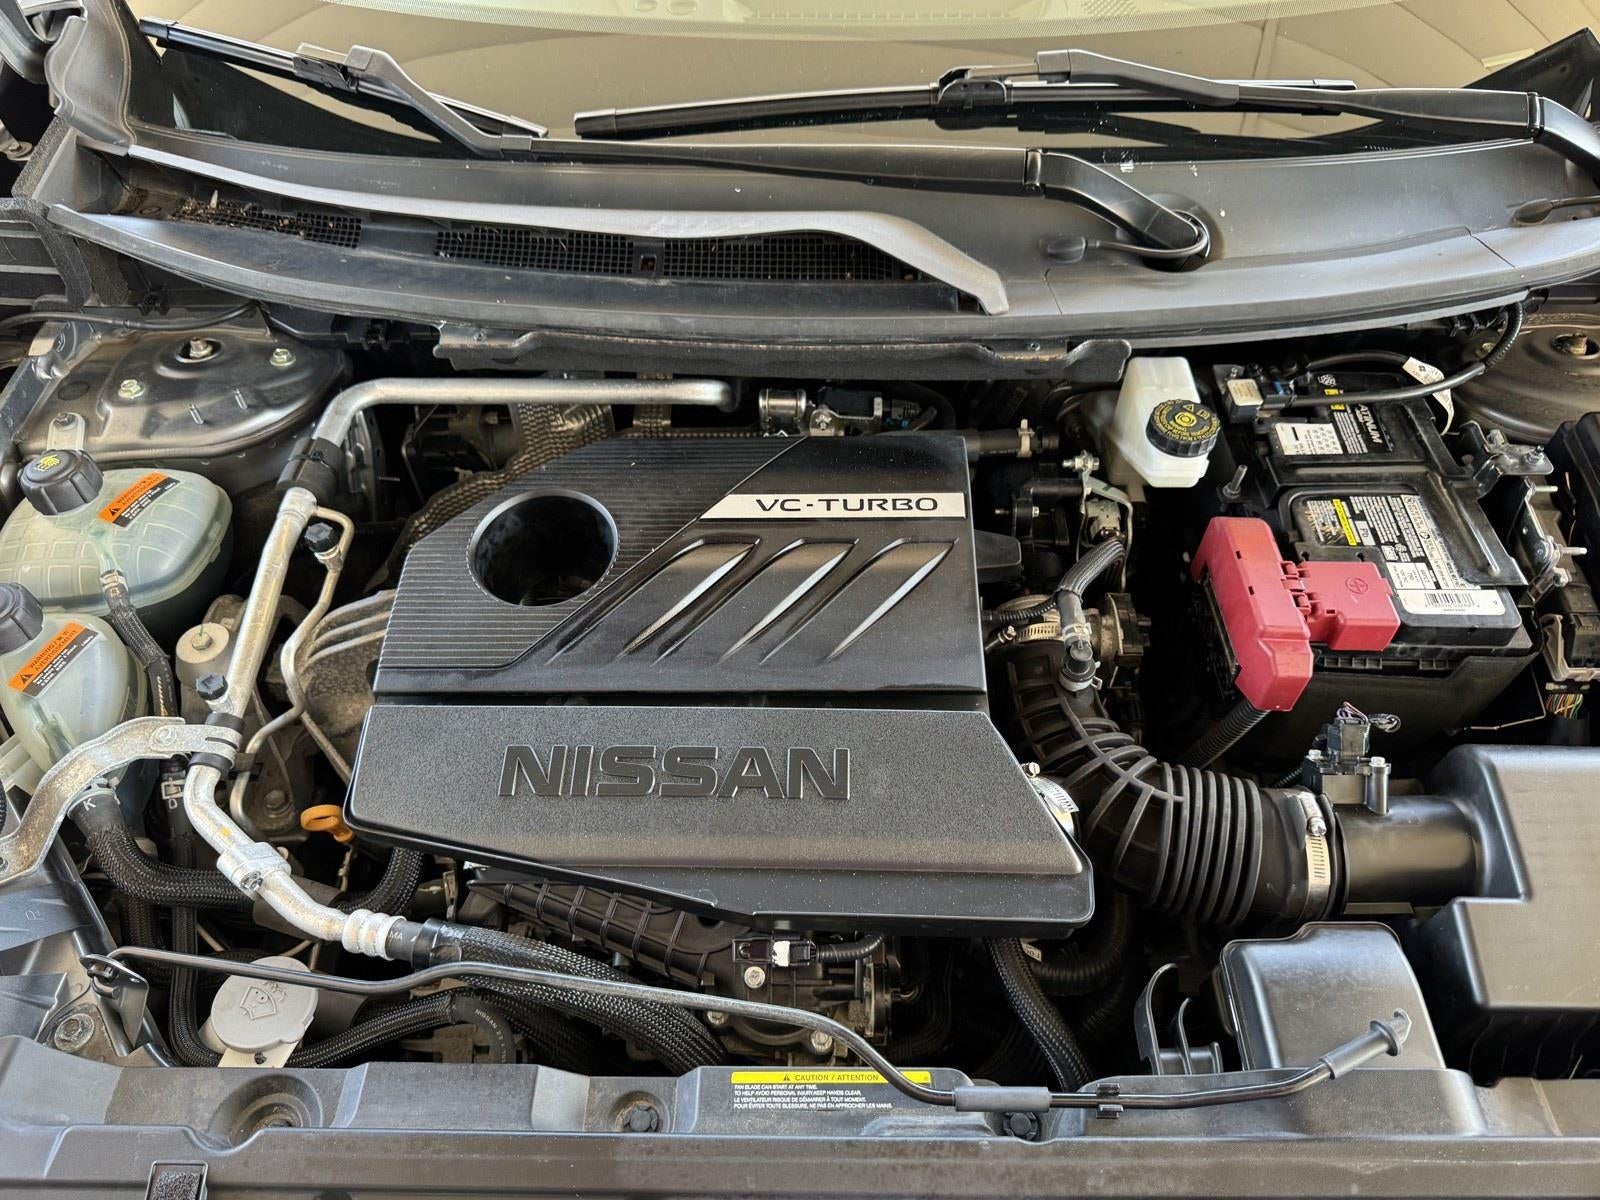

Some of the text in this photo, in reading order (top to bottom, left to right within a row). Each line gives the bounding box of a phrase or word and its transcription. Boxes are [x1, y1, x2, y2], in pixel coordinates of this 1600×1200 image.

[756, 498, 938, 512] VC-TURBO
[498, 744, 850, 800] NISSAN
[83, 798, 96, 811] K
